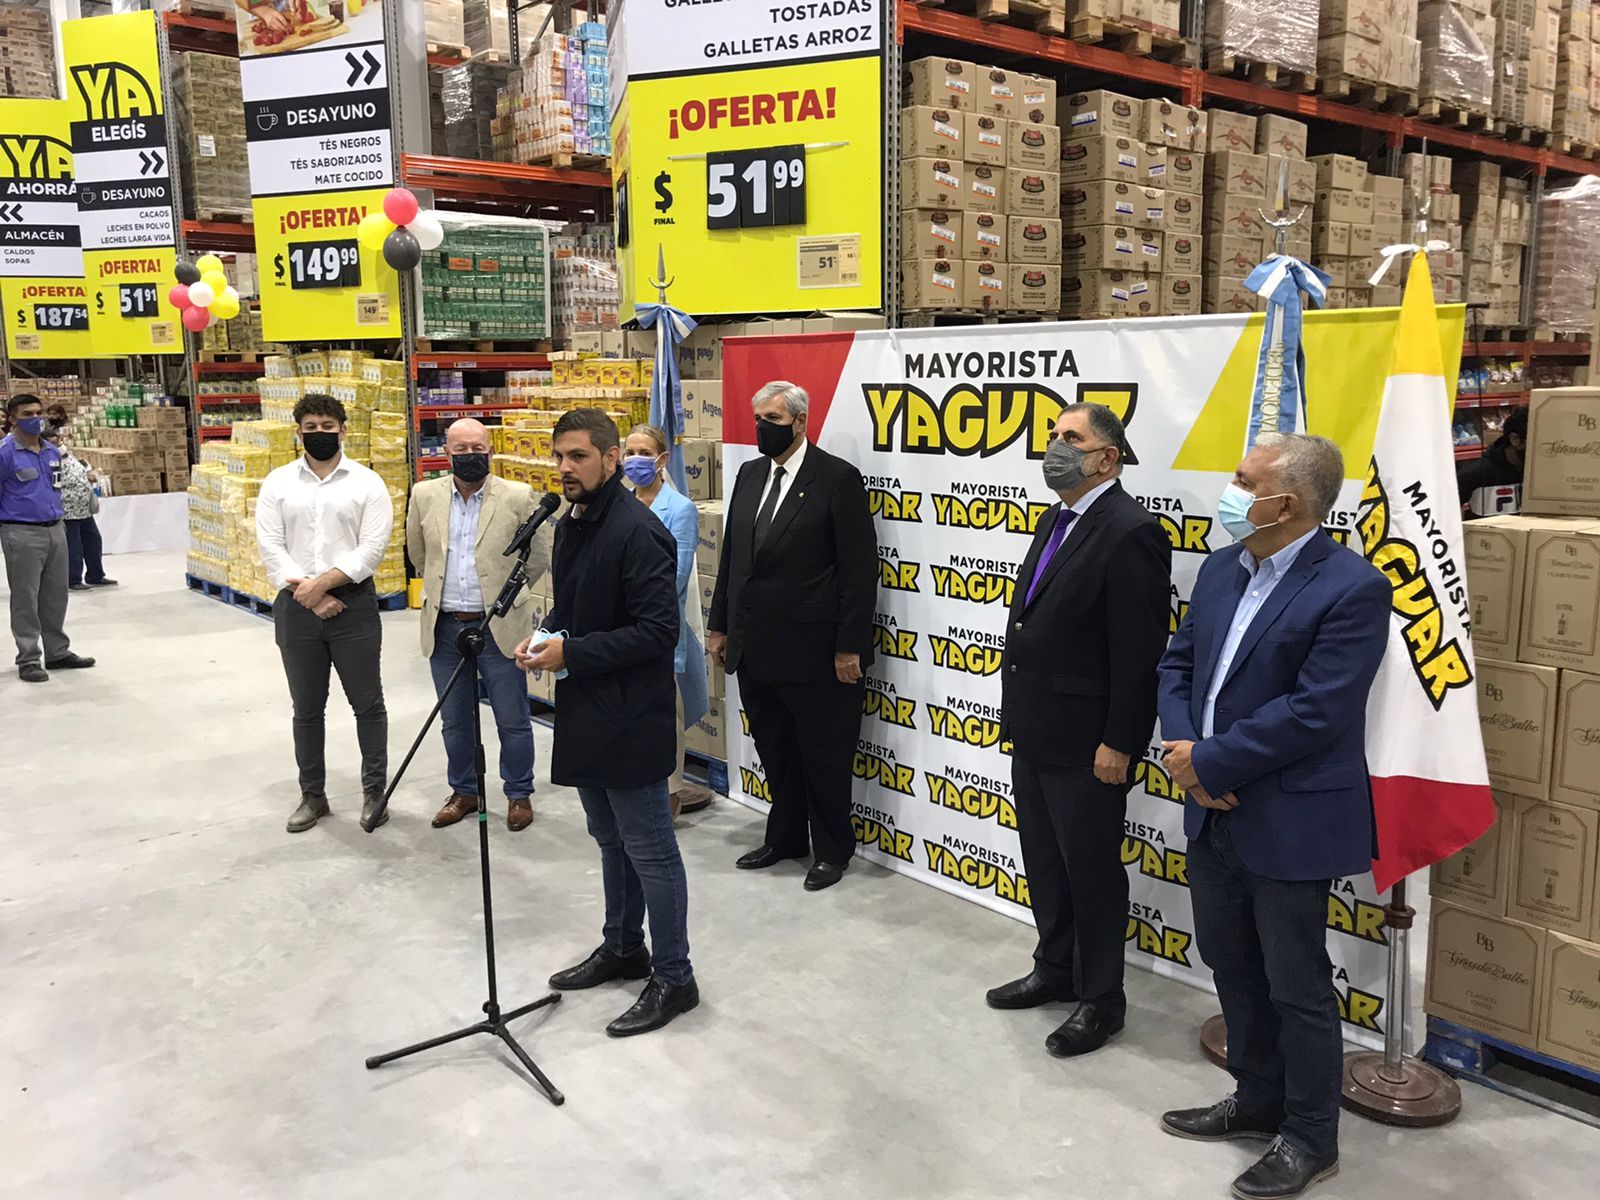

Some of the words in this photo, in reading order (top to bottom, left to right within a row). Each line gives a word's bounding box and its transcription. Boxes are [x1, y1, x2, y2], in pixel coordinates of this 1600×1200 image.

[770, 0, 872, 23] TOSTADAS
[704, 34, 799, 58] GALLETAS
[805, 25, 872, 47] ARROZ
[70, 62, 157, 121] YA
[287, 102, 376, 126] DESAYUNO
[669, 87, 836, 139] ¡OFERTA!
[91, 120, 146, 142] ELEGÍS
[320, 139, 337, 150] TÉS
[340, 136, 381, 149] NEGROS
[290, 159, 308, 170] TÉS
[311, 153, 382, 168] SABORIZADOS
[315, 174, 341, 184] MATE
[344, 170, 383, 182] COCIDO
[7, 181, 77, 195] AHORRÁ
[102, 186, 165, 201] DESAYUNO
[654, 171, 673, 213] $
[139, 210, 169, 219] CACAOS
[280, 206, 367, 234] ¡OFERTA!
[654, 217, 675, 225] FINAL
[5, 229, 64, 240] ALMACÉN
[107, 224, 133, 233] LECHES
[134, 223, 144, 231] EN
[146, 222, 170, 230] POLVO
[101, 236, 127, 244] LECHES
[128, 235, 153, 243] LARGA
[155, 233, 171, 241] VIDA
[99, 259, 161, 277] ¡OFERTA!
[274, 253, 285, 279] $
[22, 286, 86, 298] ¡OFERTA
[96, 291, 103, 309] $
[17, 309, 26, 324] $
[905, 350, 1080, 378] MAYORISTA
[951, 482, 1028, 499] MAYORISTA
[931, 493, 1051, 536] YAGUAR
[1403, 481, 1472, 640] MAYORISTA
[1485, 683, 1504, 701] BB
[943, 834, 1016, 871] MAYORISTA
[1476, 932, 1494, 951] BB
